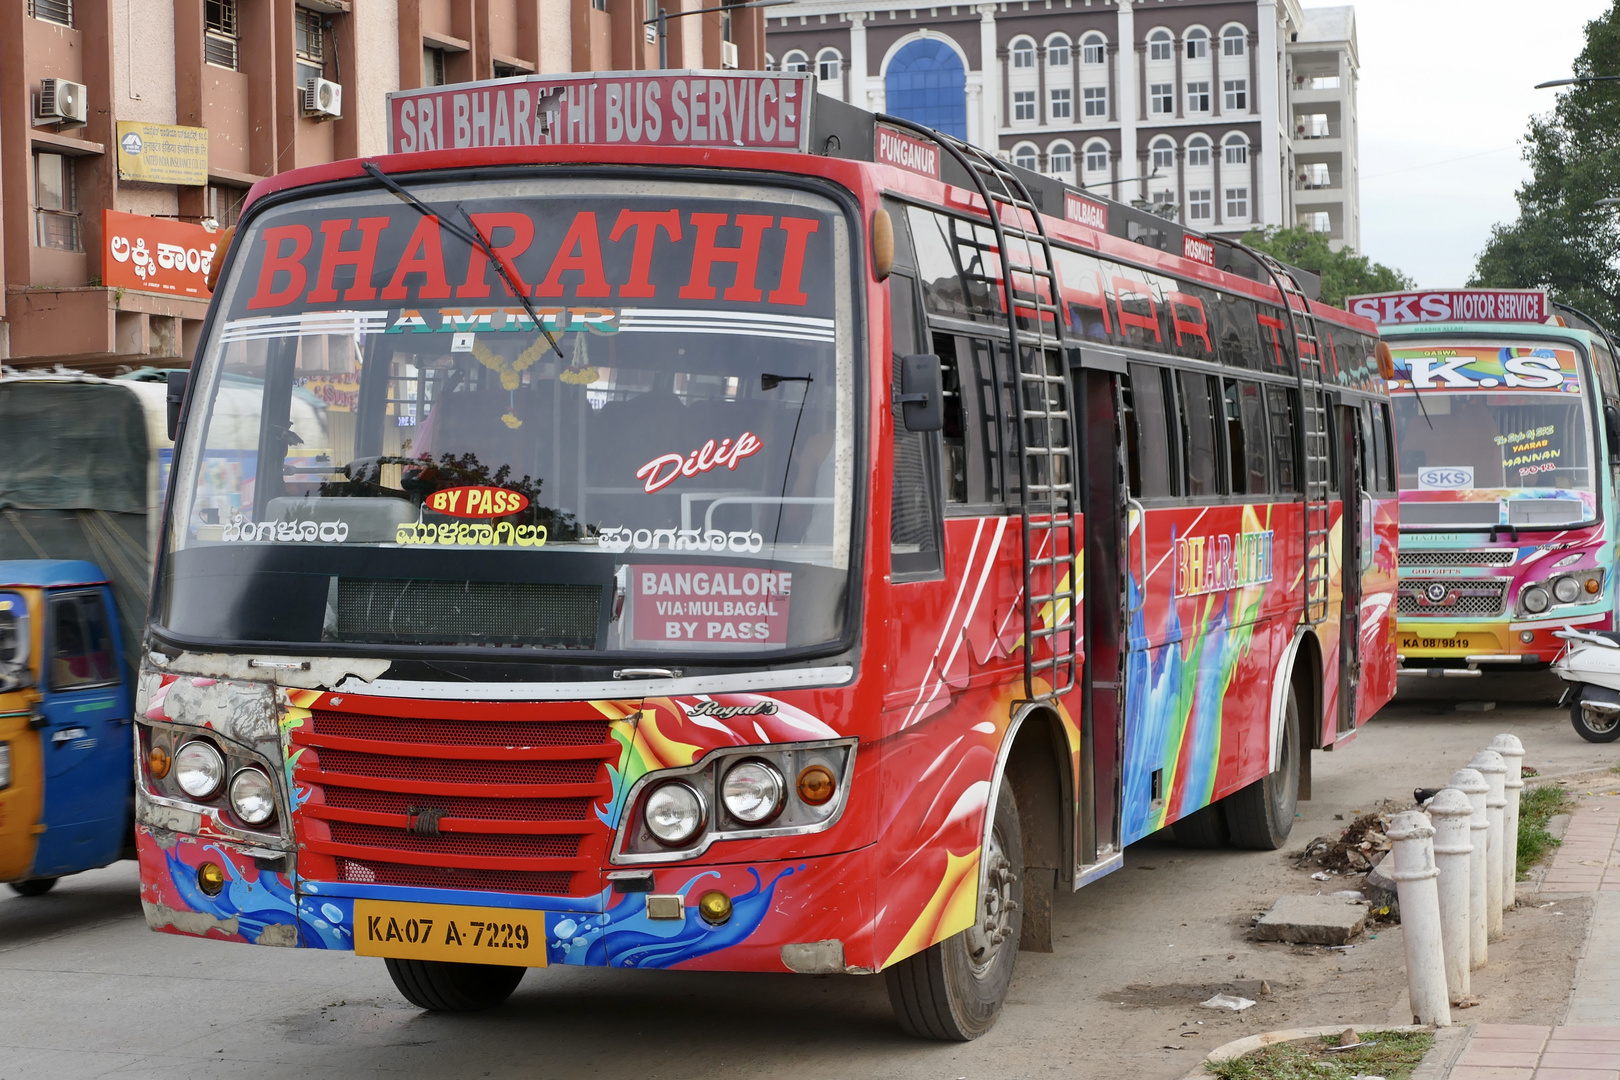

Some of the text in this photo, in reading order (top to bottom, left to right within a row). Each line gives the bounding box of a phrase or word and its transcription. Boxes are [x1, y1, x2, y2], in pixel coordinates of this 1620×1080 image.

[400, 96, 443, 153] SRI
[606, 80, 662, 142] BUS
[671, 79, 797, 145] SERVICE
[880, 133, 936, 175] PUNGANUR
[1067, 198, 1105, 230] MULBAGAL
[111, 236, 157, 281] ಲಕ್ಷ್ಮಿ
[247, 208, 819, 309] BHARATHI
[1185, 237, 1213, 265] HOSKOTE
[385, 307, 619, 333] AMMR
[1353, 293, 1539, 324] SKS MOTOR SERVICE
[1502, 449, 1561, 468] MANNAN
[1512, 440, 1549, 453] YAARAB
[636, 431, 764, 494] Dilip
[1519, 462, 1556, 476] 2018
[1426, 472, 1466, 484] SKS
[433, 489, 521, 514] BY PASS
[222, 513, 349, 543] ಬೆಂಗಳೂರು
[395, 519, 548, 547] ಮುಳಬಾಗಿಲು
[598, 524, 763, 553] ಪುಂಗನೂರು
[1174, 530, 1274, 600] BHARATHI
[642, 572, 792, 596] BANGALORE
[665, 621, 770, 639] BY PASS
[1403, 638, 1469, 648] KA 08/9819
[687, 701, 779, 719] Royal's
